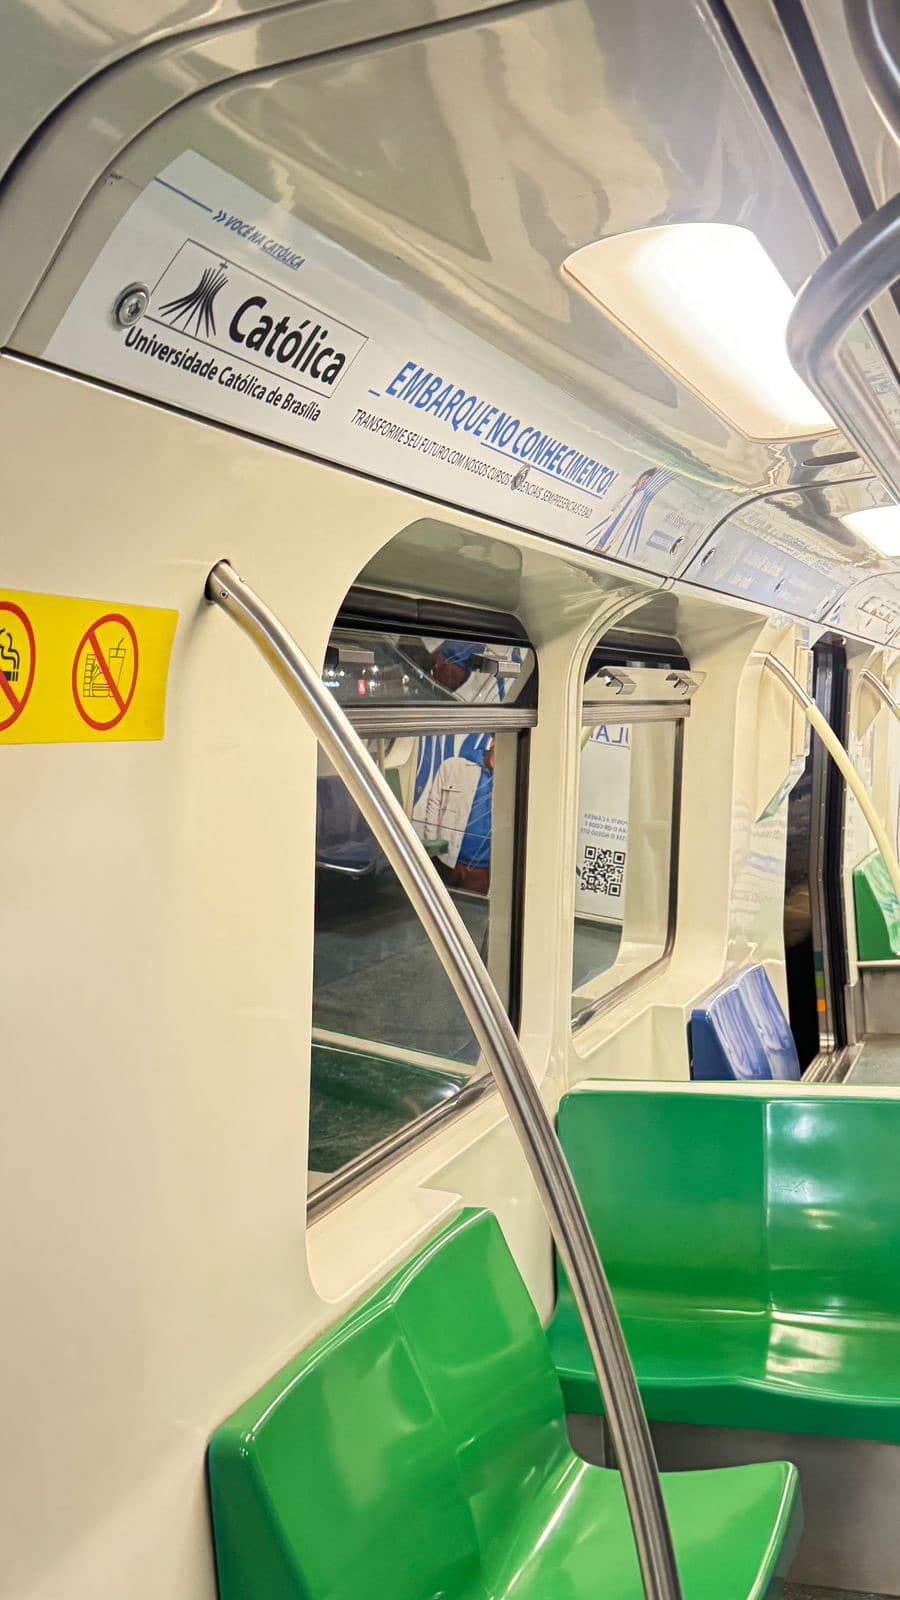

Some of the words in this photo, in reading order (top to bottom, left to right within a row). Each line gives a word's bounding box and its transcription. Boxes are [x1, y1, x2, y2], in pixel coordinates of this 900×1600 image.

[247, 230, 266, 246] NA
[261, 239, 306, 270] CATÓLICA
[124, 325, 218, 381] Universidade
[217, 366, 267, 400] Católica
[265, 386, 282, 407] de
[281, 392, 322, 422] Brasília
[229, 295, 346, 385] Católica
[351, 408, 409, 443] TRANSFORME
[403, 431, 424, 449] SEU
[417, 437, 450, 460] FUTURO
[447, 450, 467, 467] COM
[461, 456, 491, 477] NOSSOS
[385, 361, 500, 437] EMBARQUE
[484, 412, 520, 447] NO
[511, 426, 619, 495] CONHECIMENTO!
